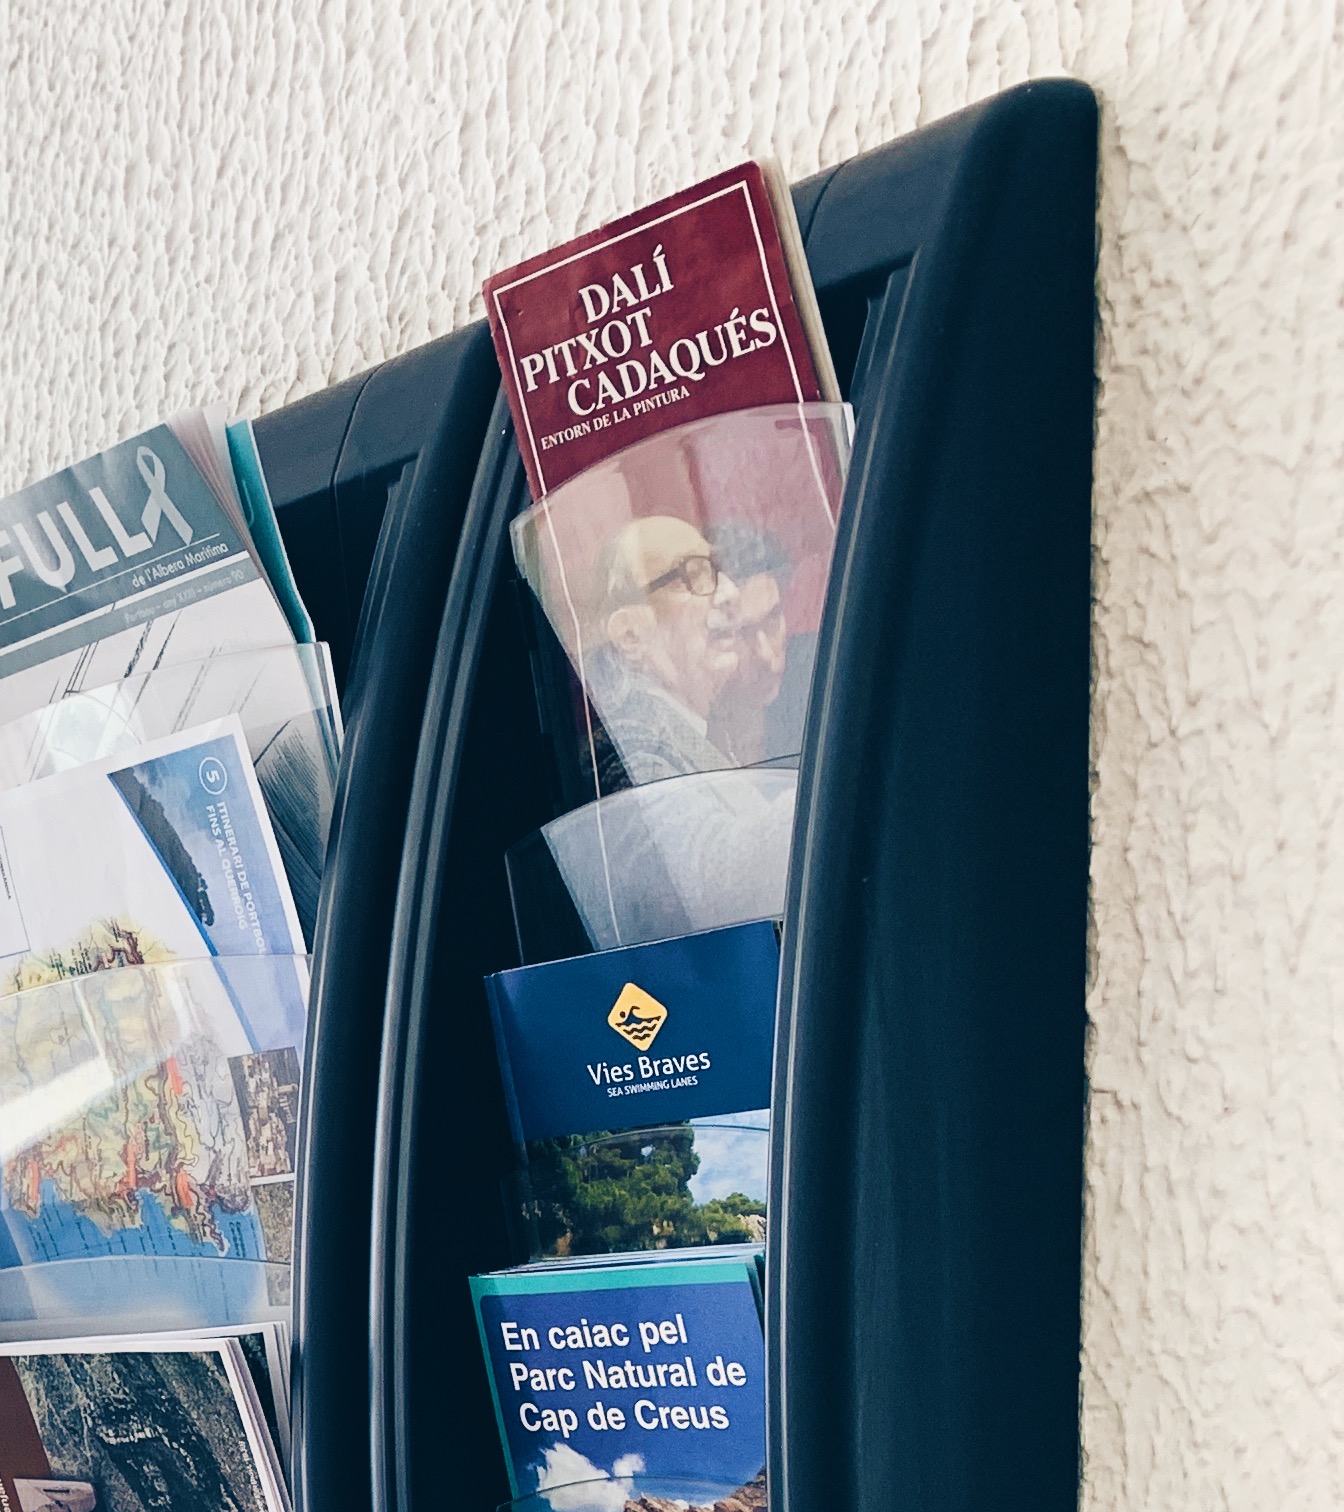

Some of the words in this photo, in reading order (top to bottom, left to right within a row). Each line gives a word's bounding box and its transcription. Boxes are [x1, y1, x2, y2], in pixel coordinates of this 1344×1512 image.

[578, 244, 674, 324] DALÍ
[520, 307, 652, 392] PITXOT
[567, 307, 777, 417] CADAQUÉS
[541, 418, 591, 450] ENTORN
[593, 412, 612, 429] DE
[613, 405, 632, 423] LA
[633, 385, 691, 417] PINTURA
[133, 575, 145, 588] de
[146, 561, 185, 581] l'Albera
[206, 769, 220, 783] 5
[206, 805, 221, 836] FINS
[215, 839, 225, 858] AL
[217, 801, 243, 871] ITINERARI
[236, 872, 246, 891] DE
[587, 1060, 634, 1086] Vies
[638, 1051, 711, 1079] Braves
[607, 1086, 623, 1098] SEA
[624, 1079, 670, 1095] SWIMMING
[671, 1075, 698, 1090] LANES
[501, 1321, 540, 1352] En
[549, 1318, 629, 1349] caiac
[639, 1314, 688, 1353] pel
[509, 1362, 576, 1391] Parc
[583, 1357, 697, 1390] Natural
[706, 1355, 747, 1387] de
[520, 1402, 578, 1438] Cap
[587, 1402, 626, 1431] de
[634, 1399, 730, 1430] Creus
